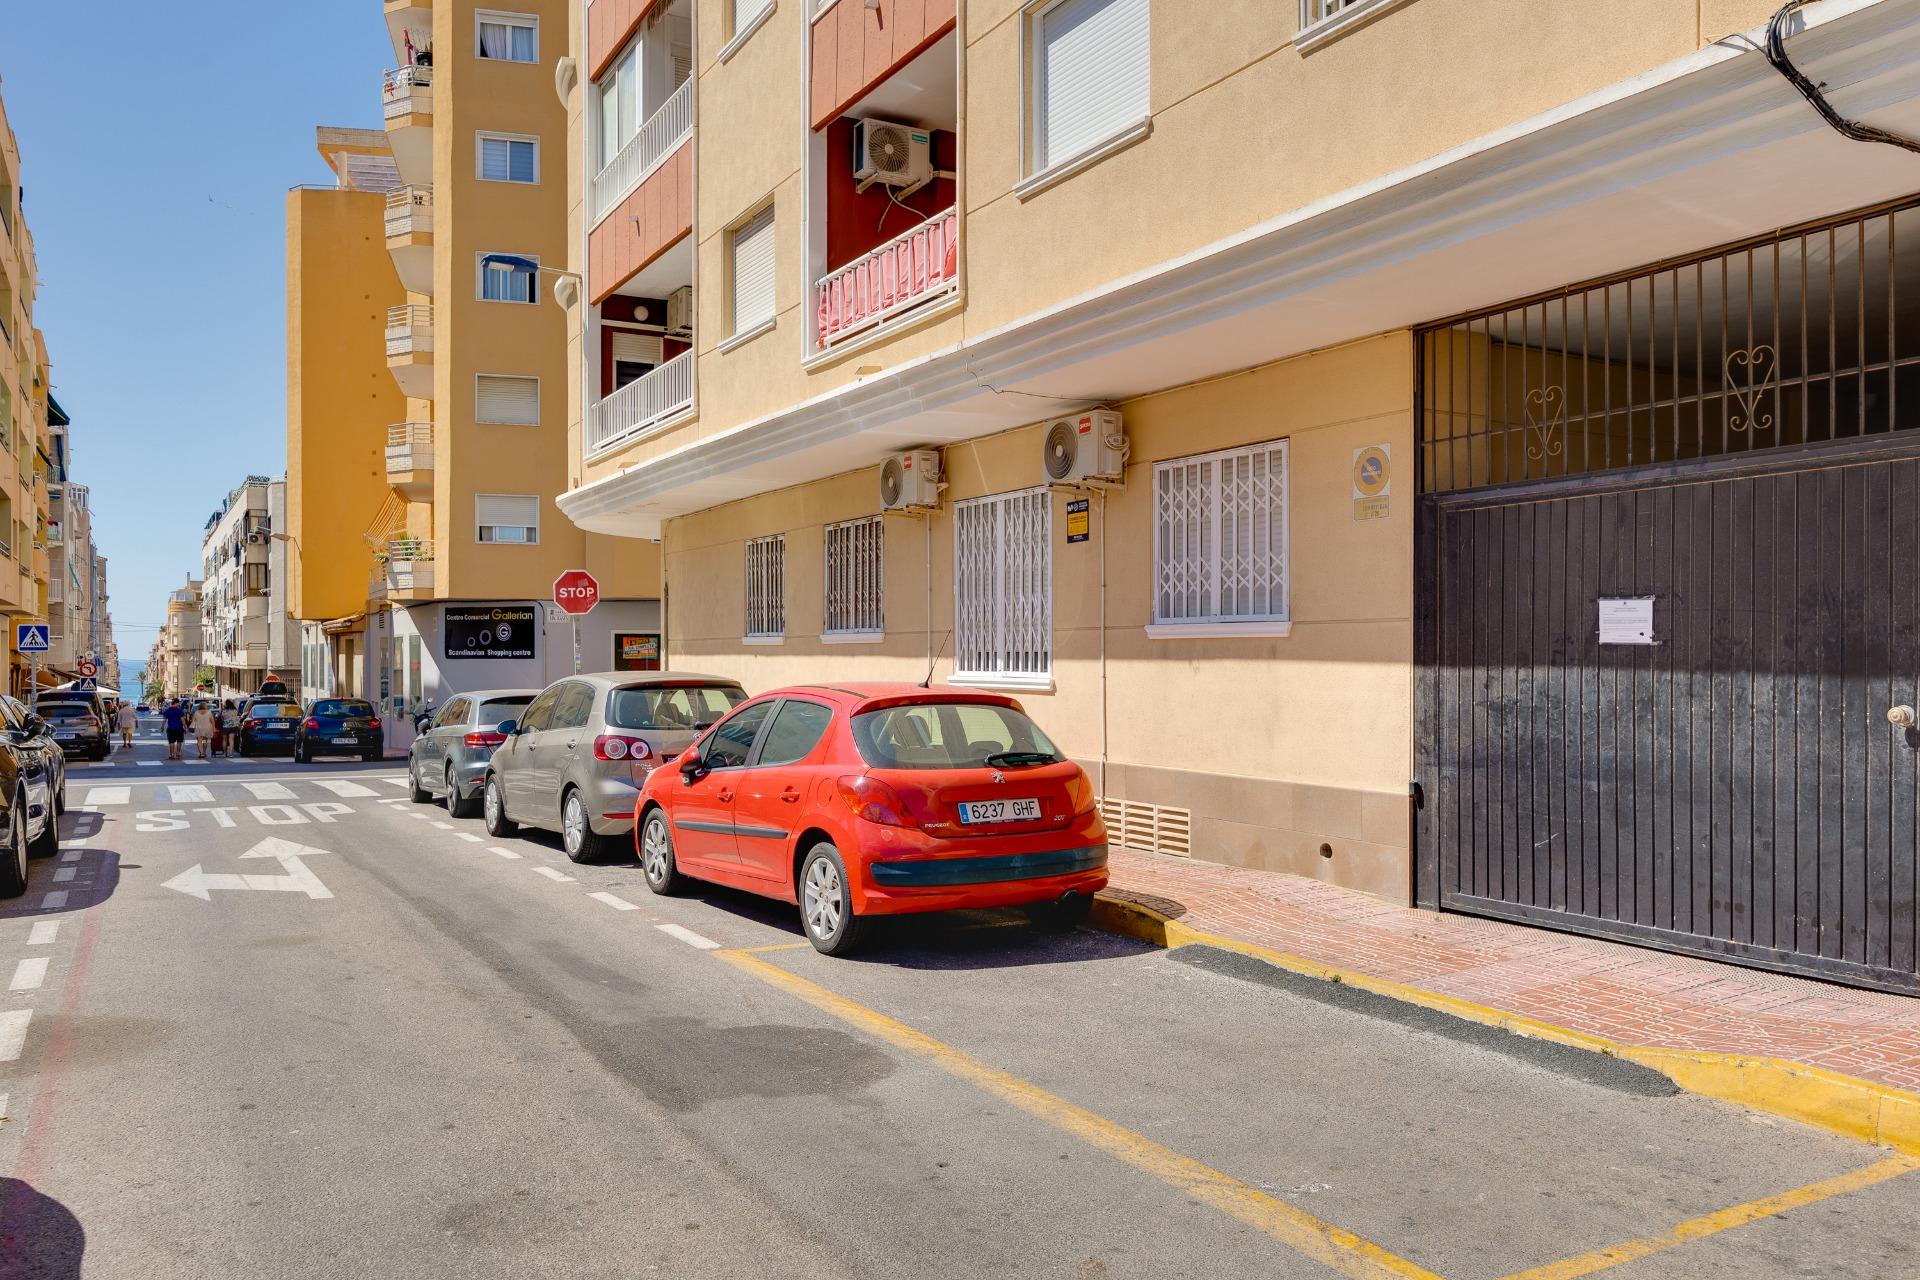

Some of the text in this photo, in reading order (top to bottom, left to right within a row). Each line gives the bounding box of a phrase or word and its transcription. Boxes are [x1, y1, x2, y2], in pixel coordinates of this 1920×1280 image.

[559, 587, 595, 598] STOP
[491, 608, 533, 620] Gallerian
[487, 649, 512, 657] Shopping
[971, 802, 1005, 820] 6237
[1012, 800, 1036, 816] GHF
[135, 802, 357, 832] STOP
